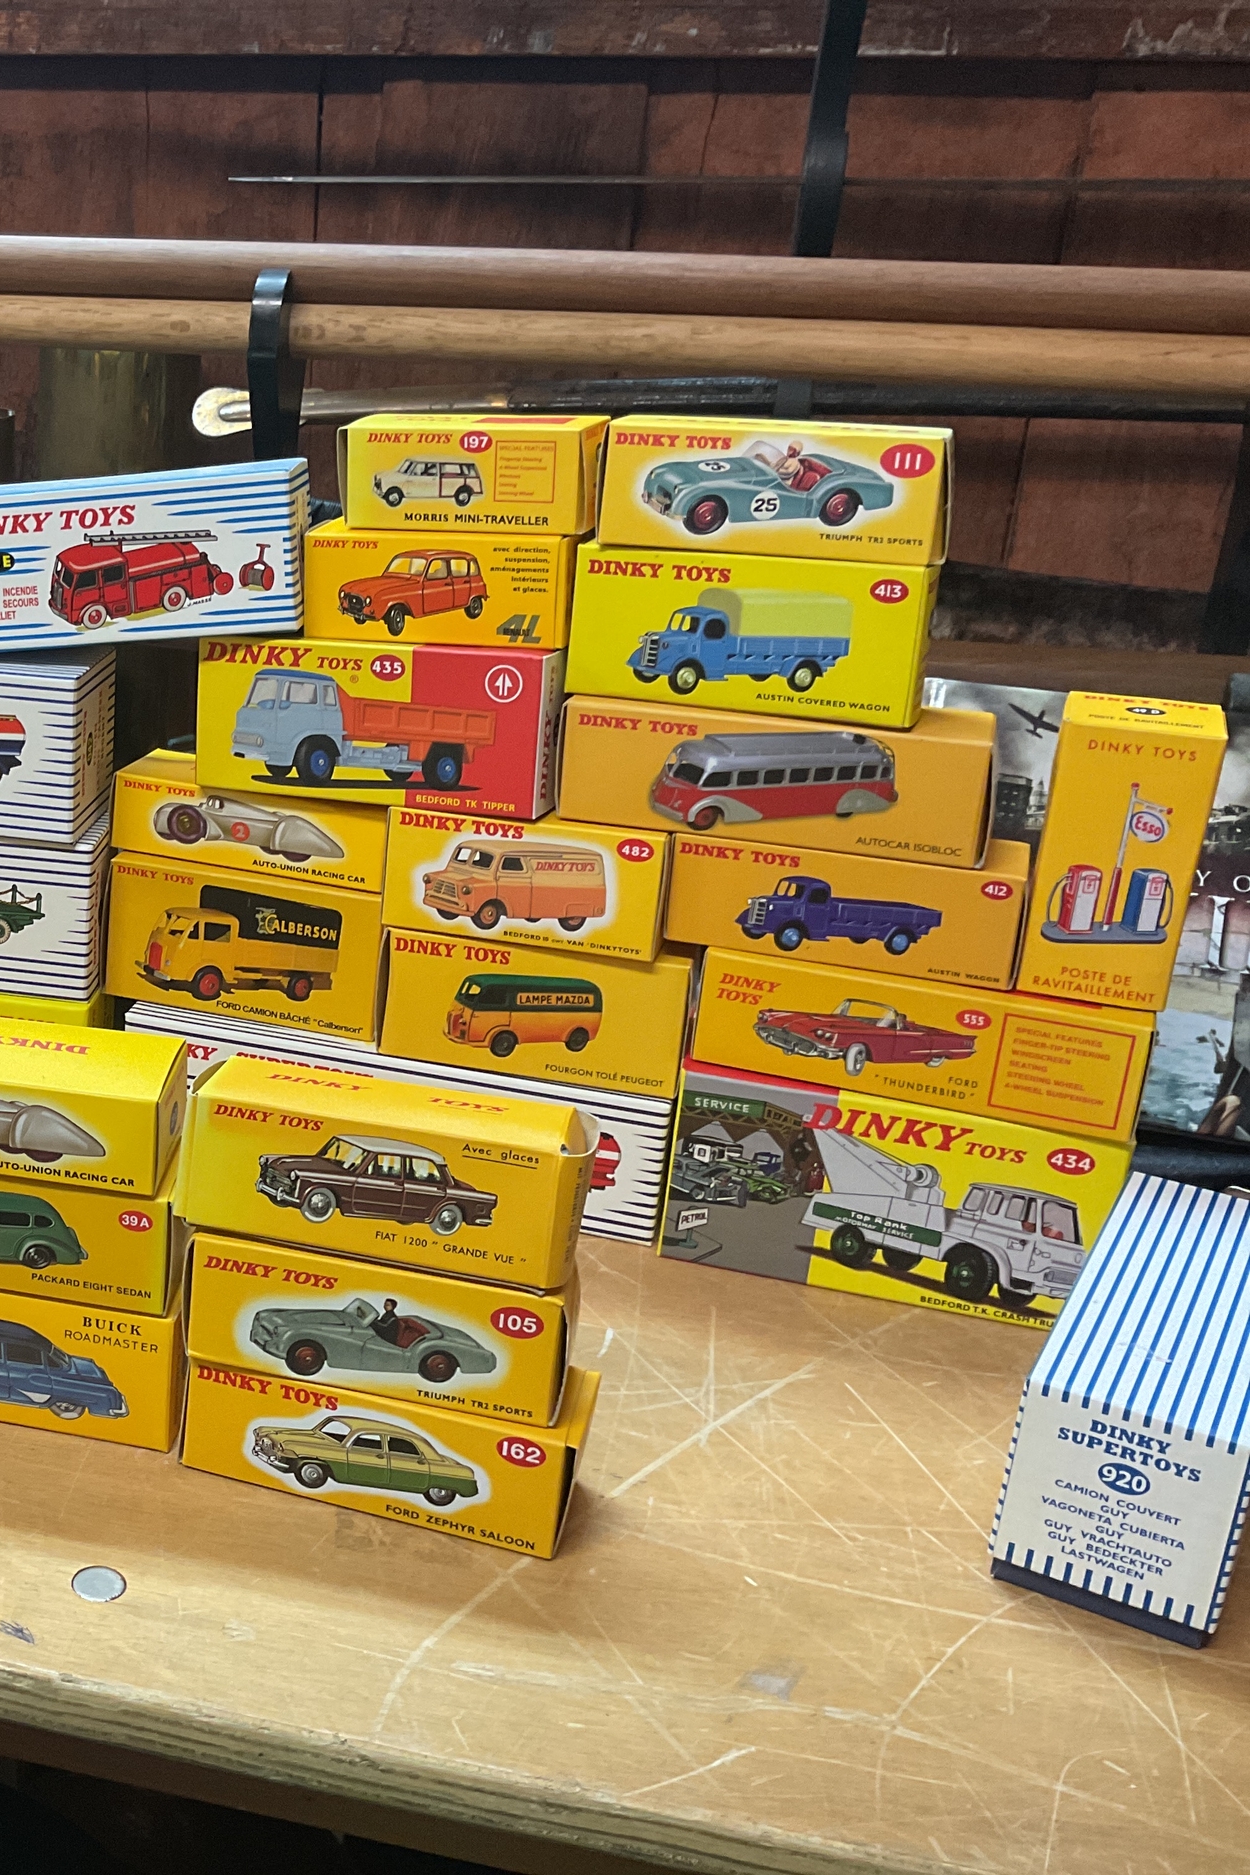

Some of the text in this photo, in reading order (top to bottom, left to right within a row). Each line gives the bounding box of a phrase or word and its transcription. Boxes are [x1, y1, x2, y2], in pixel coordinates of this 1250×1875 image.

[463, 436, 488, 449] 197
[894, 452, 922, 470] 111
[753, 498, 777, 512] 25
[404, 513, 549, 526] MORRIS MINI-TRAVELLER
[3, 586, 38, 597] INCENDIE
[874, 584, 901, 598] 413
[3, 598, 39, 608] SECOURS
[204, 641, 363, 671] DINKY TOYS
[372, 661, 402, 674] 435
[756, 692, 890, 712] AUSTIN COVERED WAGON
[415, 794, 515, 812] BEDFORD TK TIPPER
[235, 824, 245, 838] 2
[1134, 815, 1162, 837] Esso
[621, 845, 649, 857] 482
[856, 836, 962, 857] AUTOCAR ISOBLOC
[252, 859, 366, 884] AUTO-UNION RACING CAR
[984, 883, 1009, 896] 412
[265, 914, 338, 942] CALBERSON
[719, 973, 781, 994] DINKY
[1061, 967, 1132, 986] POSTE DE
[519, 994, 590, 1005] LAMPE MAZDA
[716, 988, 763, 1006] TOYS
[1032, 976, 1156, 1003] RAVITAILLEMENT
[963, 1014, 985, 1026] 555
[1016, 1027, 1103, 1048] SPECIAL FEATURES
[545, 1064, 664, 1088] FOURGON TOLÉ PEUGEOT
[1009, 1060, 1048, 1072] SEATING
[948, 1076, 978, 1089] FORD
[694, 1098, 750, 1113] SERVICE
[802, 1103, 973, 1151] DINKY
[964, 1141, 1027, 1164] TOYS
[462, 1144, 540, 1165] Avec glaces
[1051, 1153, 1091, 1169] 434
[64, 1168, 108, 1183] RACING
[111, 1177, 135, 1187] CAR
[681, 1210, 706, 1224] PETROL
[31, 1273, 152, 1298] PACKARD EIGHT SEDAN
[82, 1316, 142, 1336] BUICK
[497, 1314, 538, 1333] 105
[64, 1330, 158, 1354] ROADMASTER
[417, 1389, 534, 1418] TRIUMPH TR2 SPORTS
[1089, 1419, 1172, 1455] DINKY
[502, 1442, 541, 1464] 162
[1057, 1427, 1201, 1482] SUPERTOYS
[1102, 1467, 1148, 1491] 920
[1055, 1479, 1181, 1526] CAMION COUVERT
[1100, 1505, 1131, 1520] GUY
[386, 1504, 536, 1551] FORD ZEPHYR SALOON
[1041, 1496, 1186, 1551] VAGONETA CUBIERTA
[1095, 1525, 1125, 1540] GUY
[1044, 1519, 1172, 1567] GUY VRACHTAUTO
[1047, 1531, 1164, 1576] GUY BEDECKTER
[1061, 1547, 1145, 1580] LASTWAGEN
